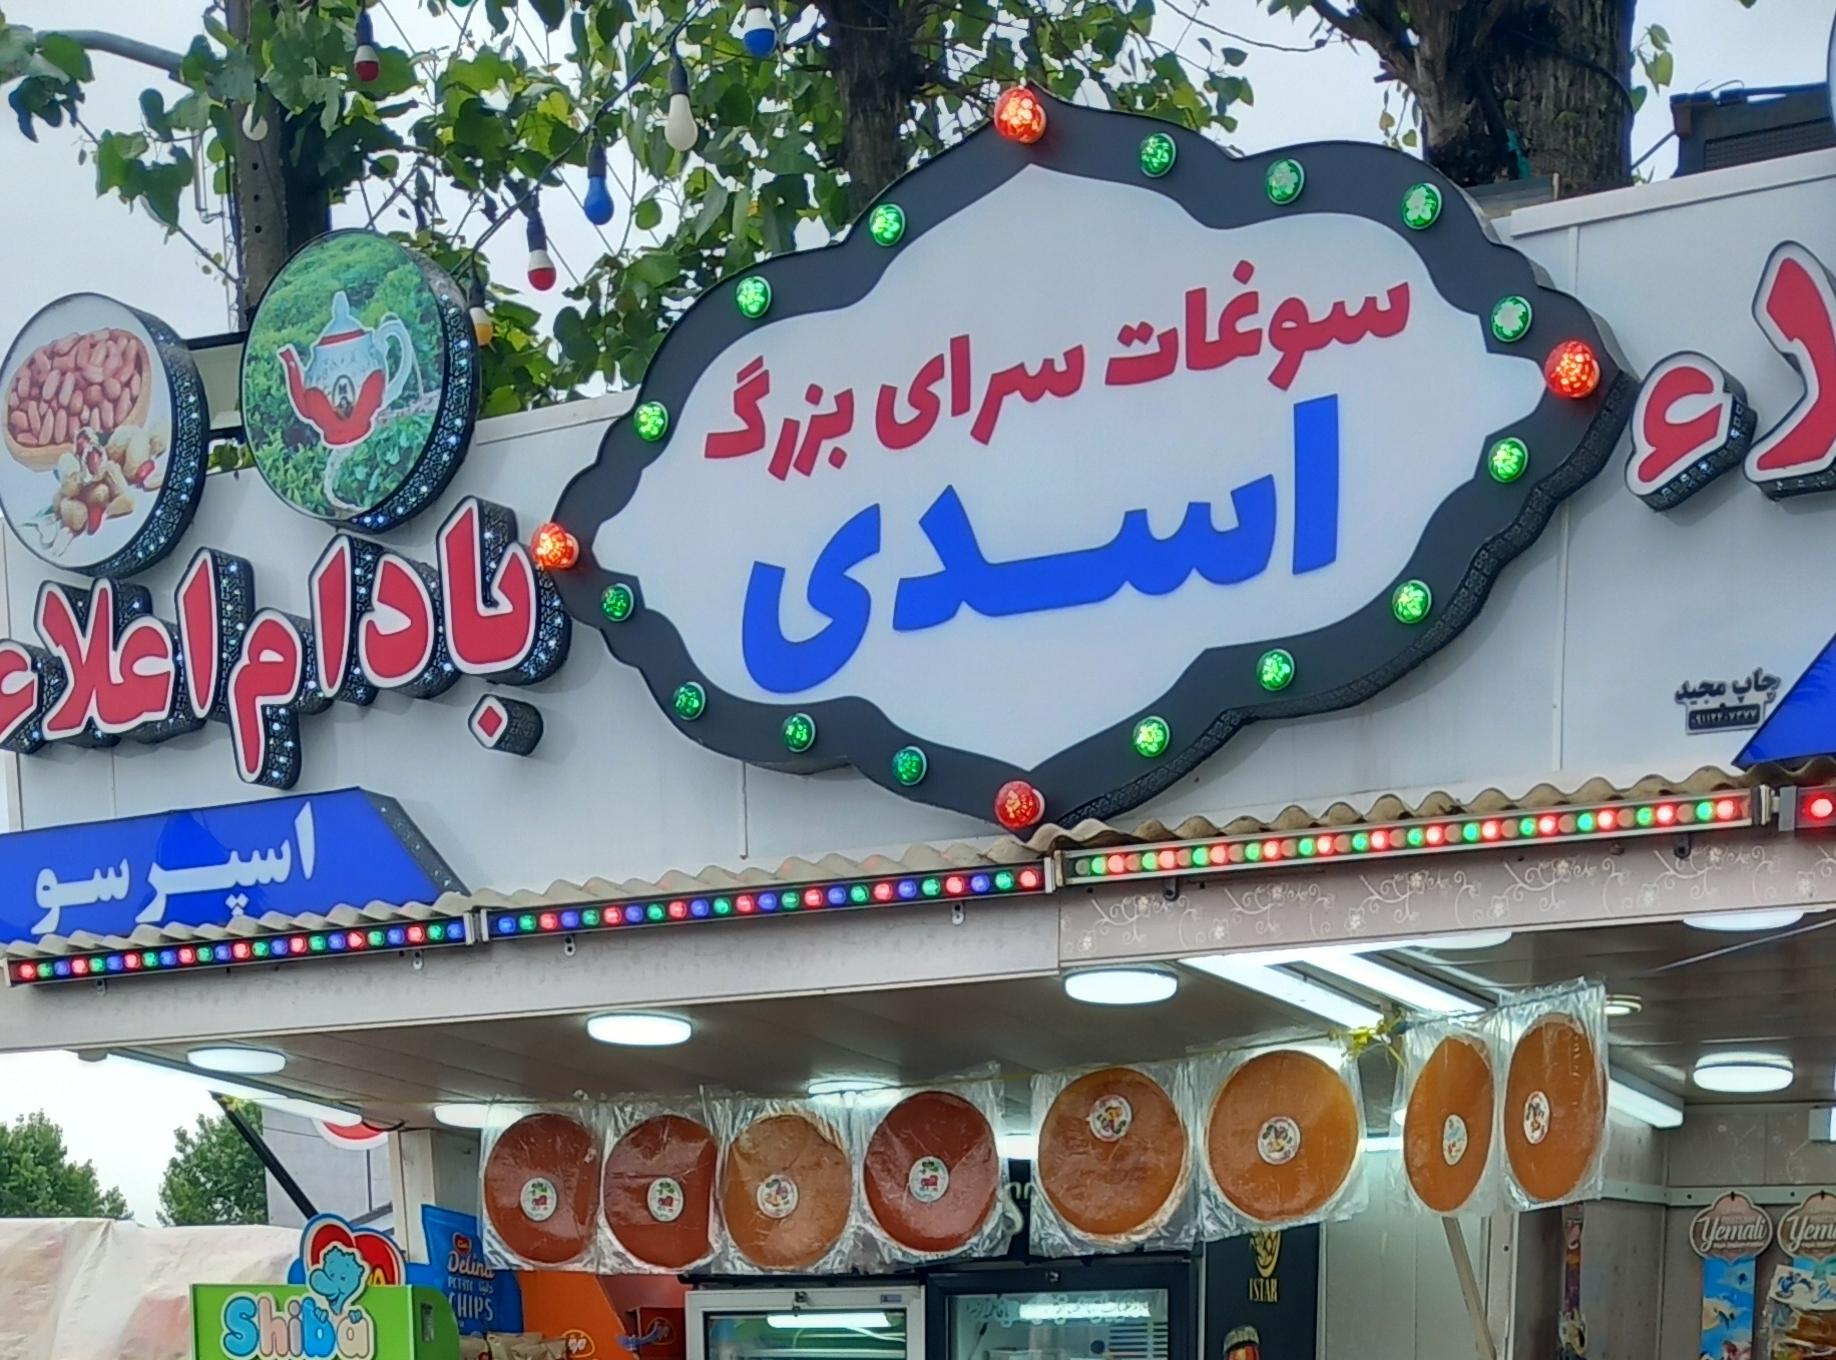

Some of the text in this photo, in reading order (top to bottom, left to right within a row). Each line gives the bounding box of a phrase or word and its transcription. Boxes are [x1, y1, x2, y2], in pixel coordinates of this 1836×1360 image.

[704, 259, 1410, 482] سوغات سرای بزرگ
[741, 393, 1339, 695] اسدی
[231, 498, 538, 786] بادام
[1674, 667, 1781, 705] چاپ مجید
[447, 1250, 496, 1279] Delina
[1695, 1214, 1768, 1252] Yemali
